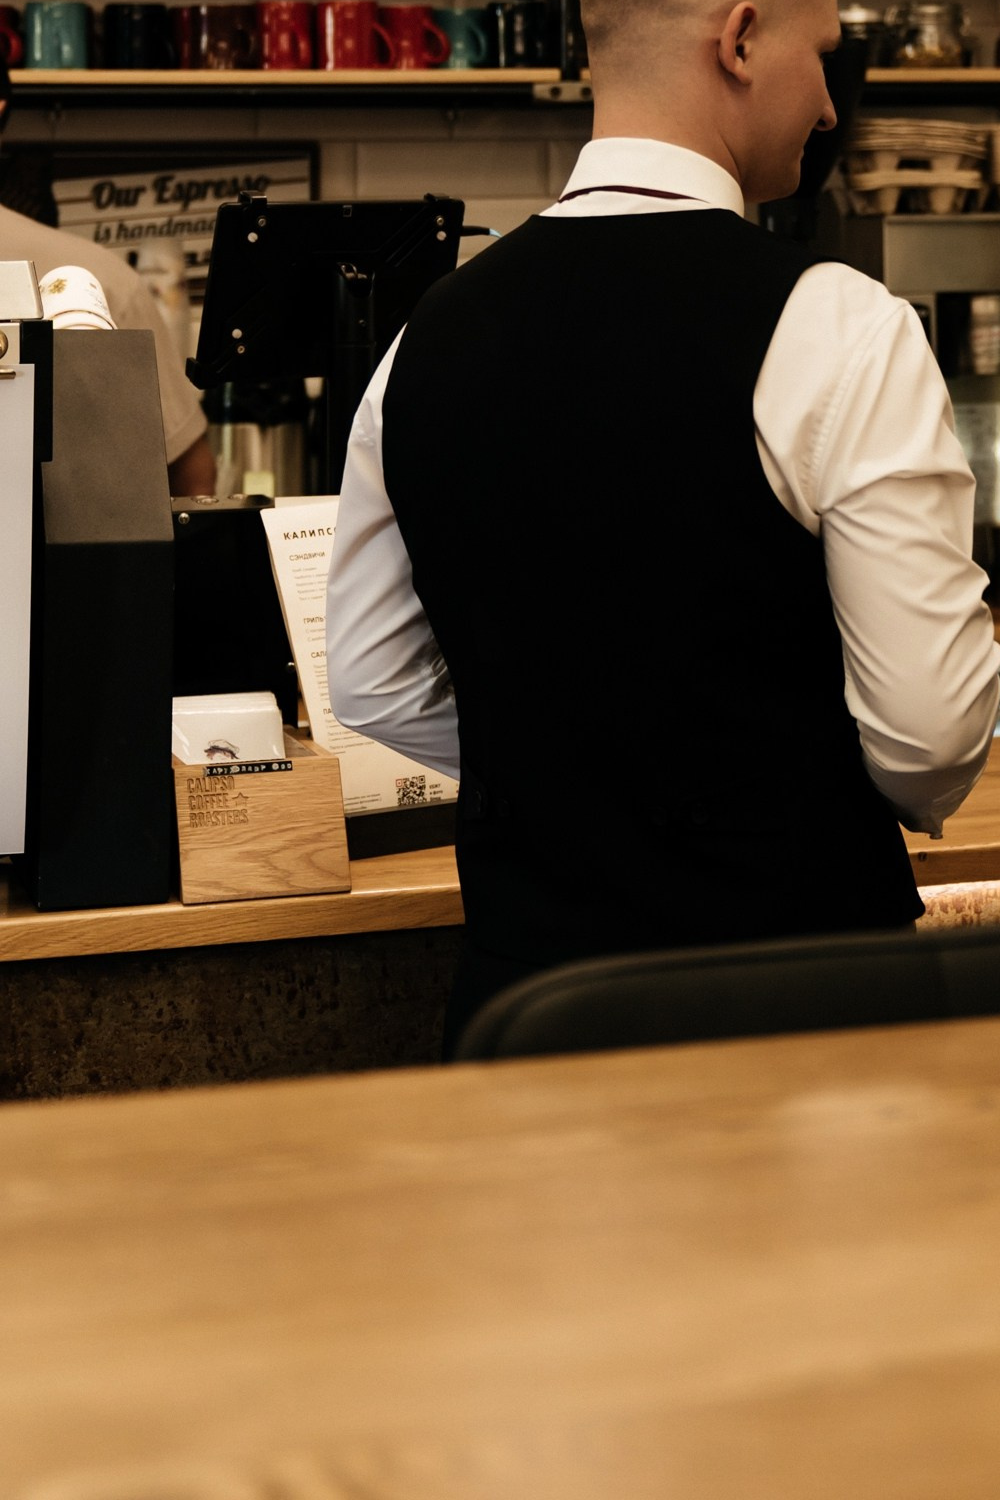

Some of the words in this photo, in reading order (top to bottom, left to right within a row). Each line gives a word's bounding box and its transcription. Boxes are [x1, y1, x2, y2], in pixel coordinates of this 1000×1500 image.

[92, 180, 145, 211] Our
[153, 174, 271, 212] Espresso
[94, 220, 111, 244] is
[284, 527, 336, 540] КАЛИПС
[289, 551, 326, 562] СЭНДВИЧИ
[187, 776, 235, 794] CALIPSO
[188, 792, 229, 810] COFFEE
[190, 809, 249, 828] ROASTERS
